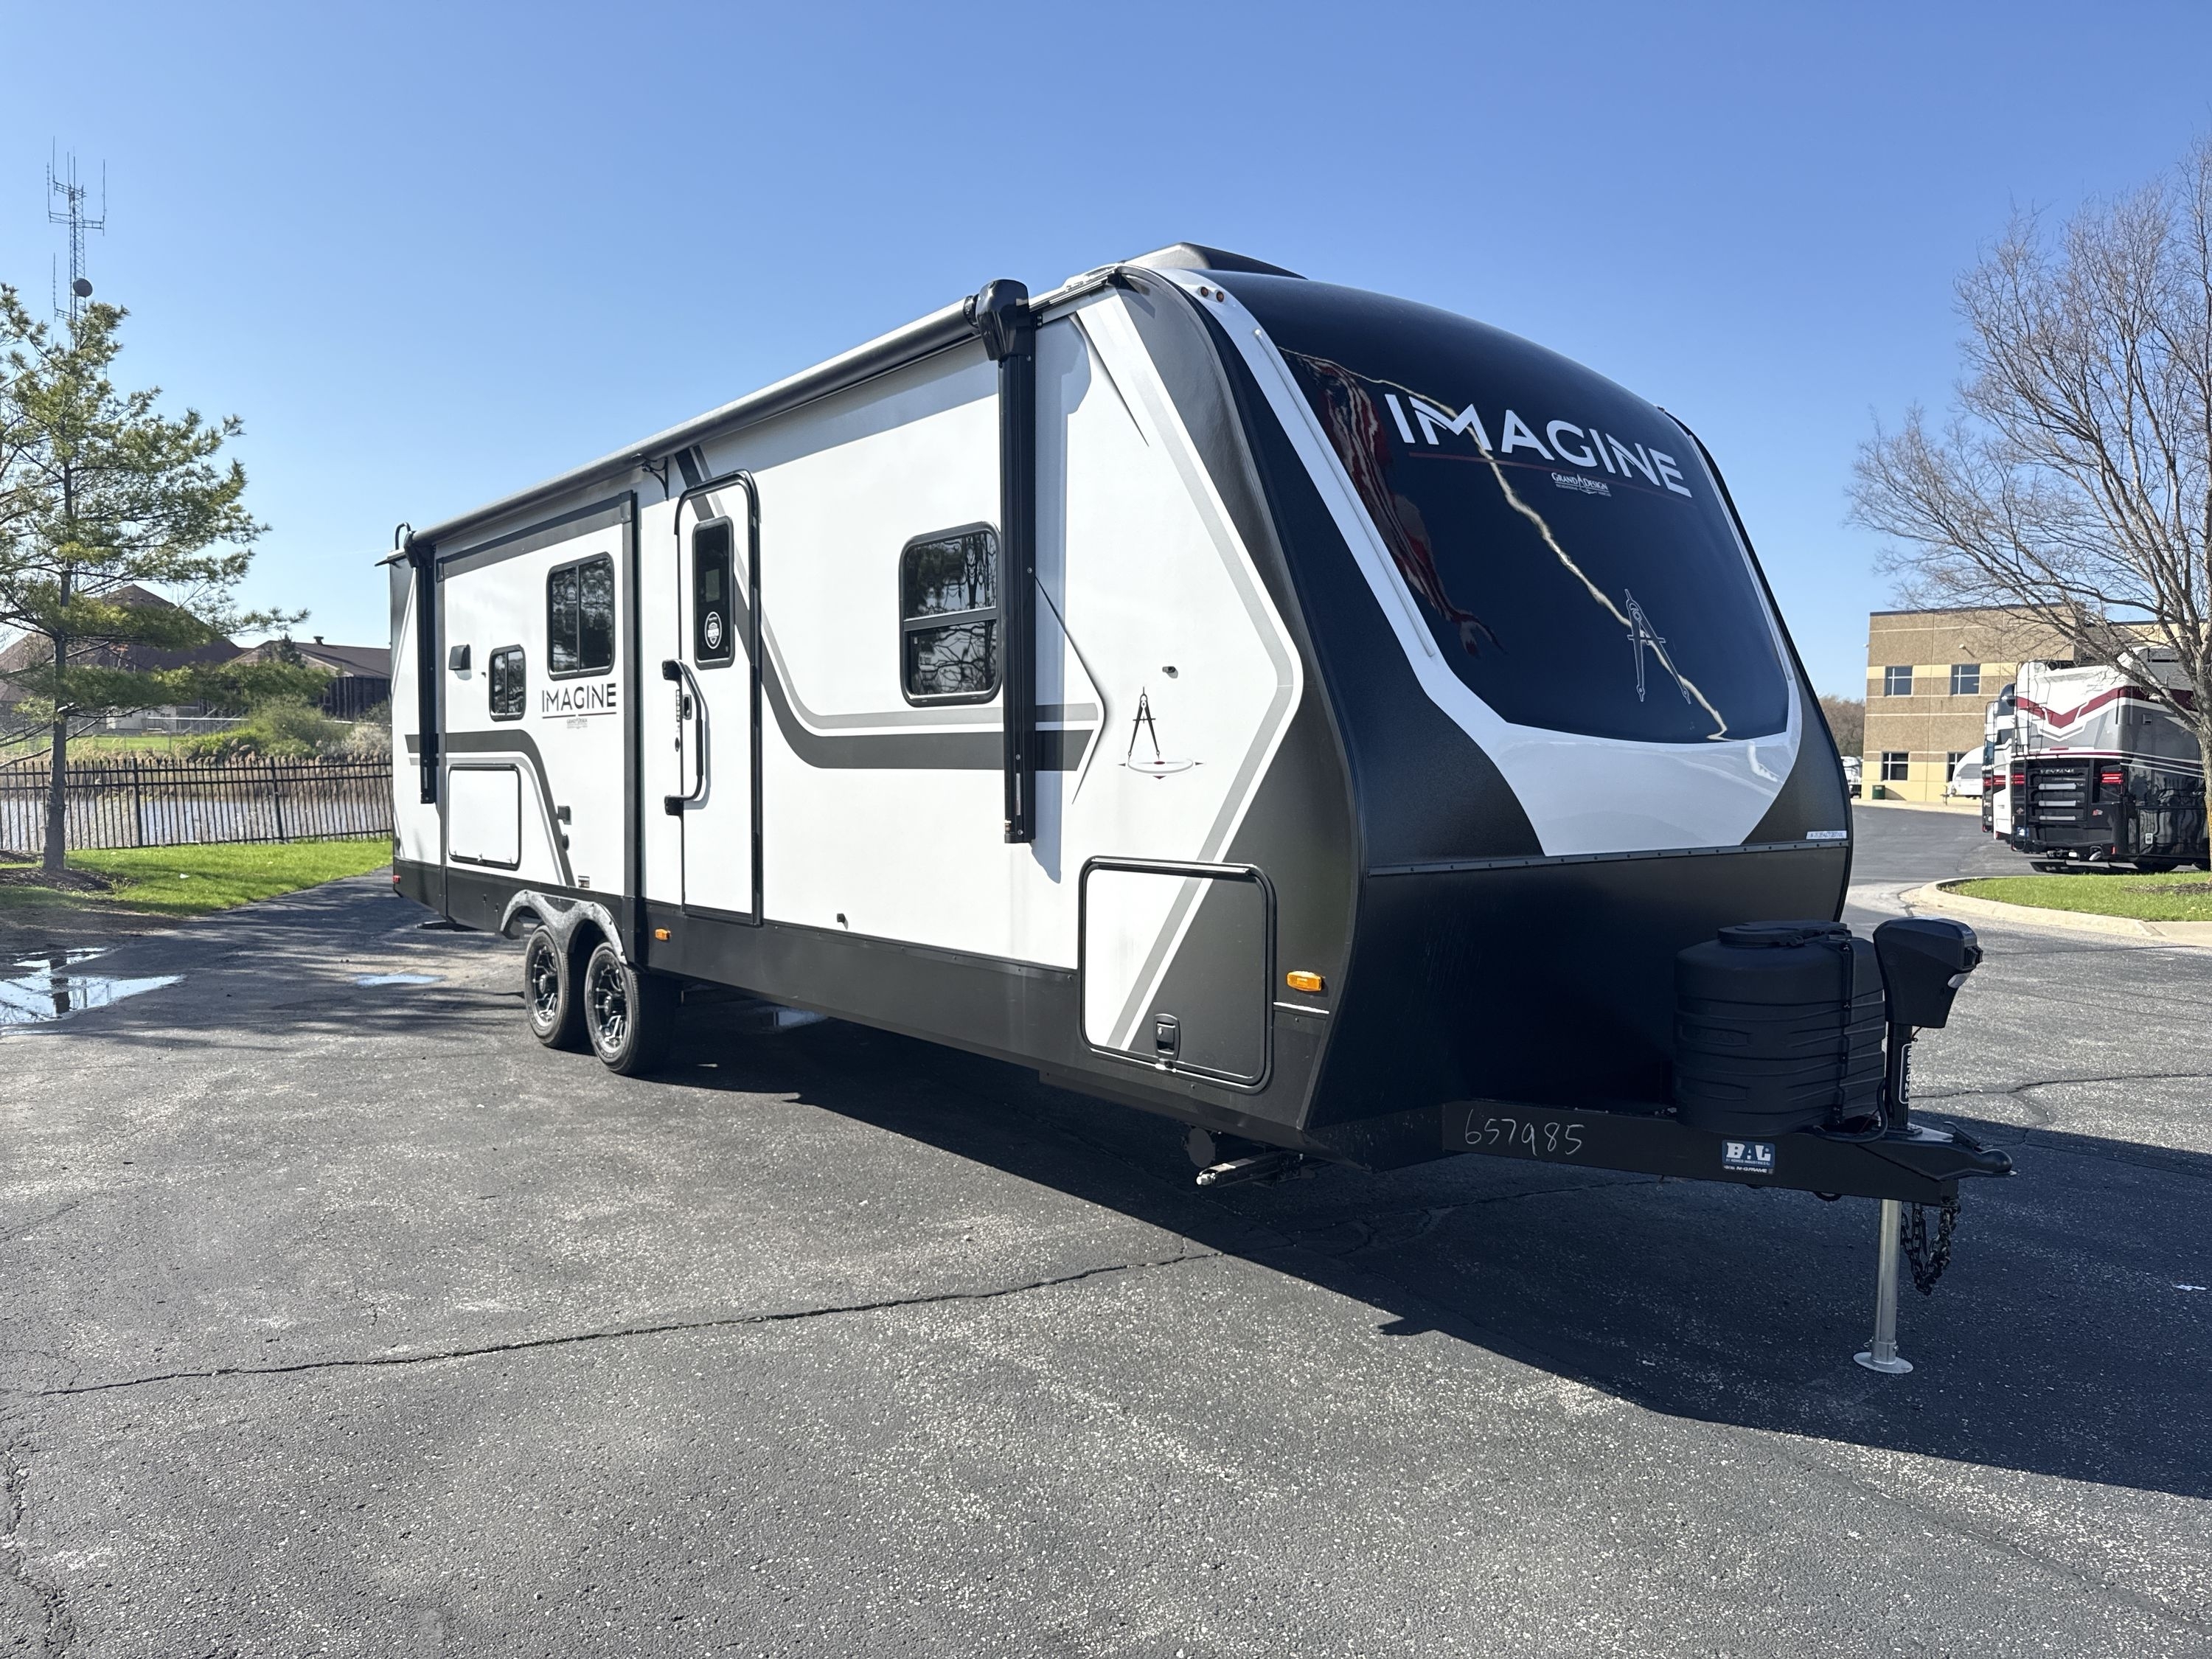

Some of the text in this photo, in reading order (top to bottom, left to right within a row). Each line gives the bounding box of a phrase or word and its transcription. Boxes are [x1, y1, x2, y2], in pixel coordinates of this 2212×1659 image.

[1384, 393, 1693, 498] IMAGINE
[1551, 472, 1579, 484] GRAND
[1582, 478, 1610, 491] DESIGN
[542, 683, 616, 712] IMAGINE
[1464, 1108, 1585, 1157] 657985
[1725, 1142, 1772, 1162] BAL
